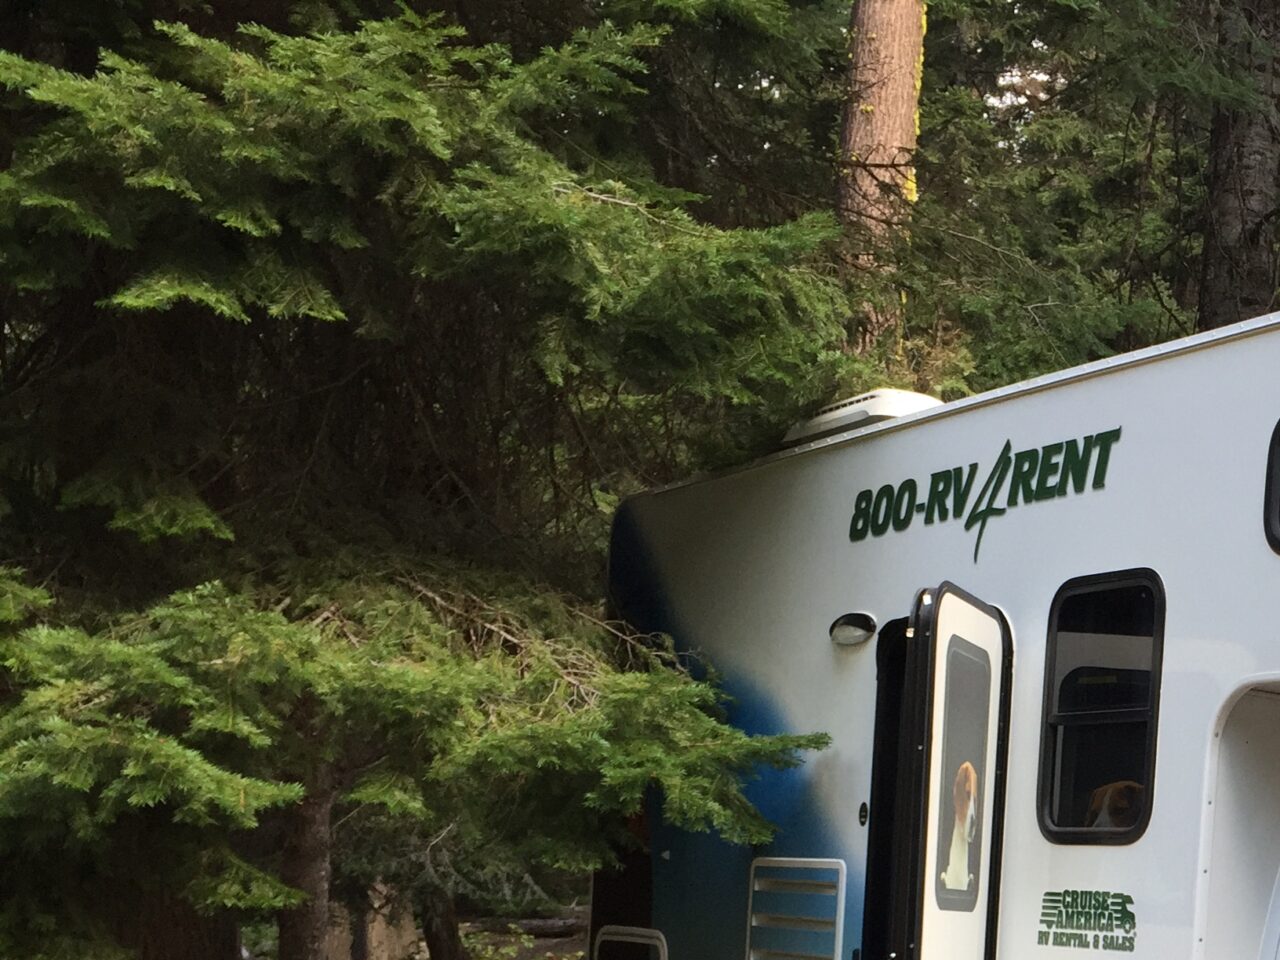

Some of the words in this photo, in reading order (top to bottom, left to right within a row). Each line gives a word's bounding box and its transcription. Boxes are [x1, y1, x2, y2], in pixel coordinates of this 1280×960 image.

[1062, 889, 1111, 911] CRUISE
[1055, 909, 1115, 932] AMERICA
[1037, 930, 1051, 946] RV
[1052, 931, 1091, 949] RENTAL
[1102, 934, 1135, 953] SALES
